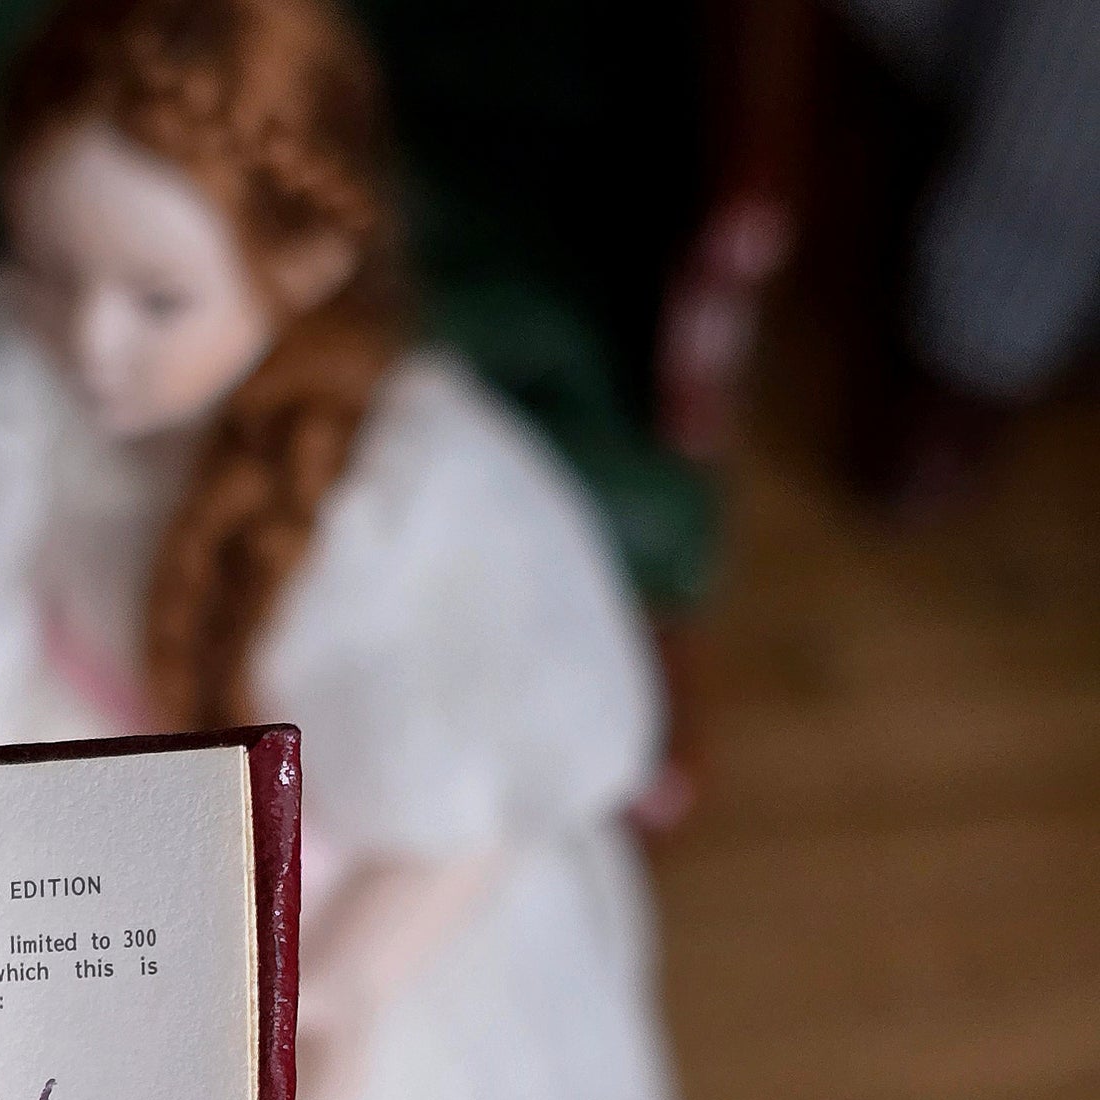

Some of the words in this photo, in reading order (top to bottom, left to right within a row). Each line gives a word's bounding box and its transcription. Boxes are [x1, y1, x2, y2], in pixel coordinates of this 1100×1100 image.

[10, 876, 102, 899] EDITION
[10, 932, 78, 954] limited
[91, 933, 111, 950] to
[123, 928, 157, 948] 300
[74, 958, 114, 979] this
[140, 956, 158, 976] is
